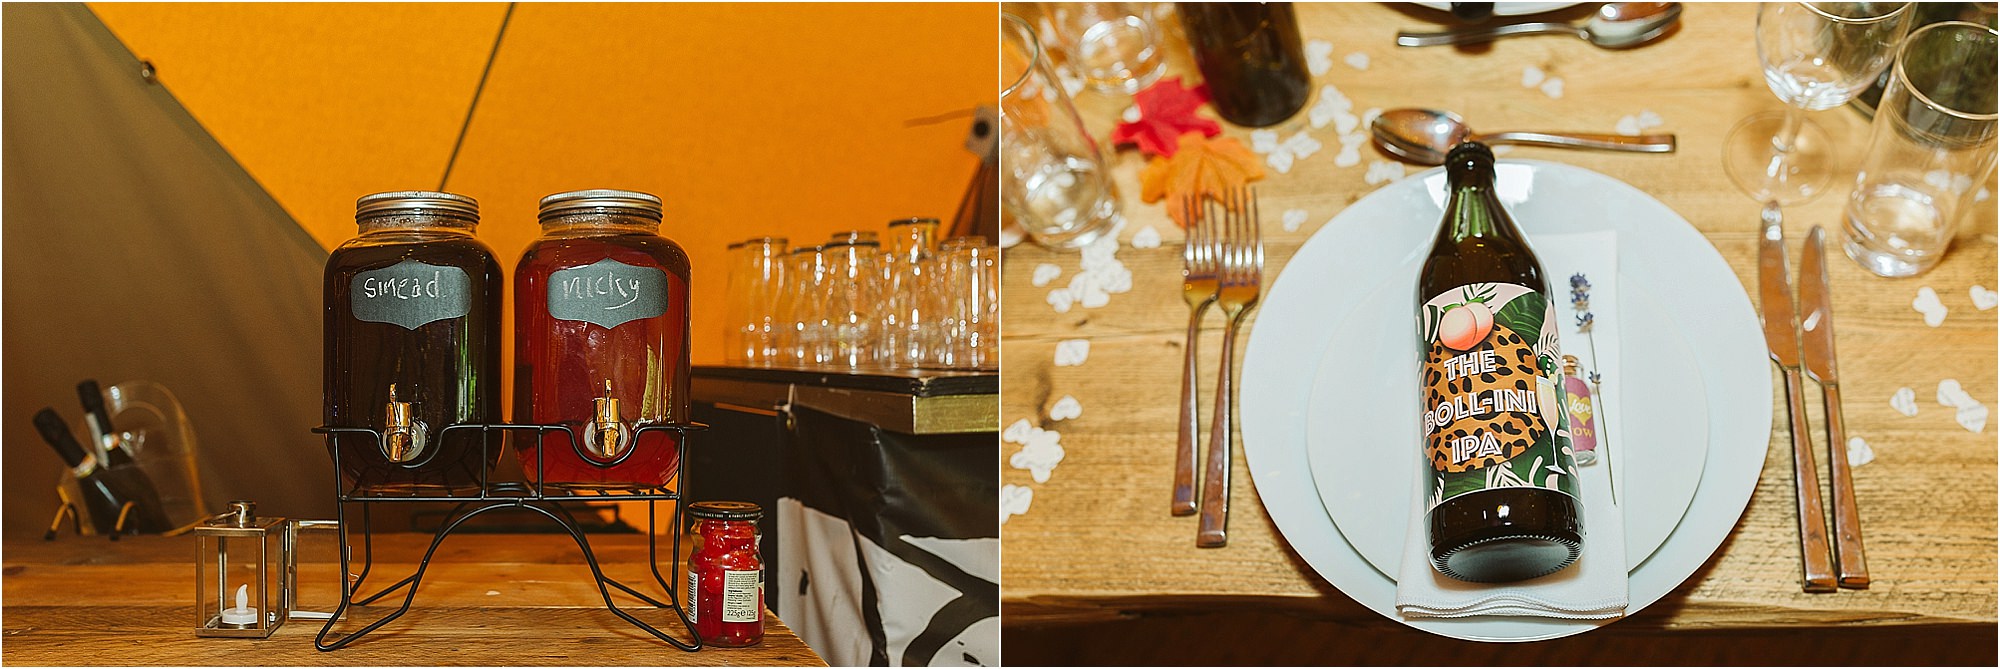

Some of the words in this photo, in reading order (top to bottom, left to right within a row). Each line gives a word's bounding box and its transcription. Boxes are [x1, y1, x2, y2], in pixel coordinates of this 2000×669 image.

[1444, 350, 1497, 382] THE
[1424, 389, 1538, 436] BOLL-INI
[1451, 432, 1503, 465] IPA
